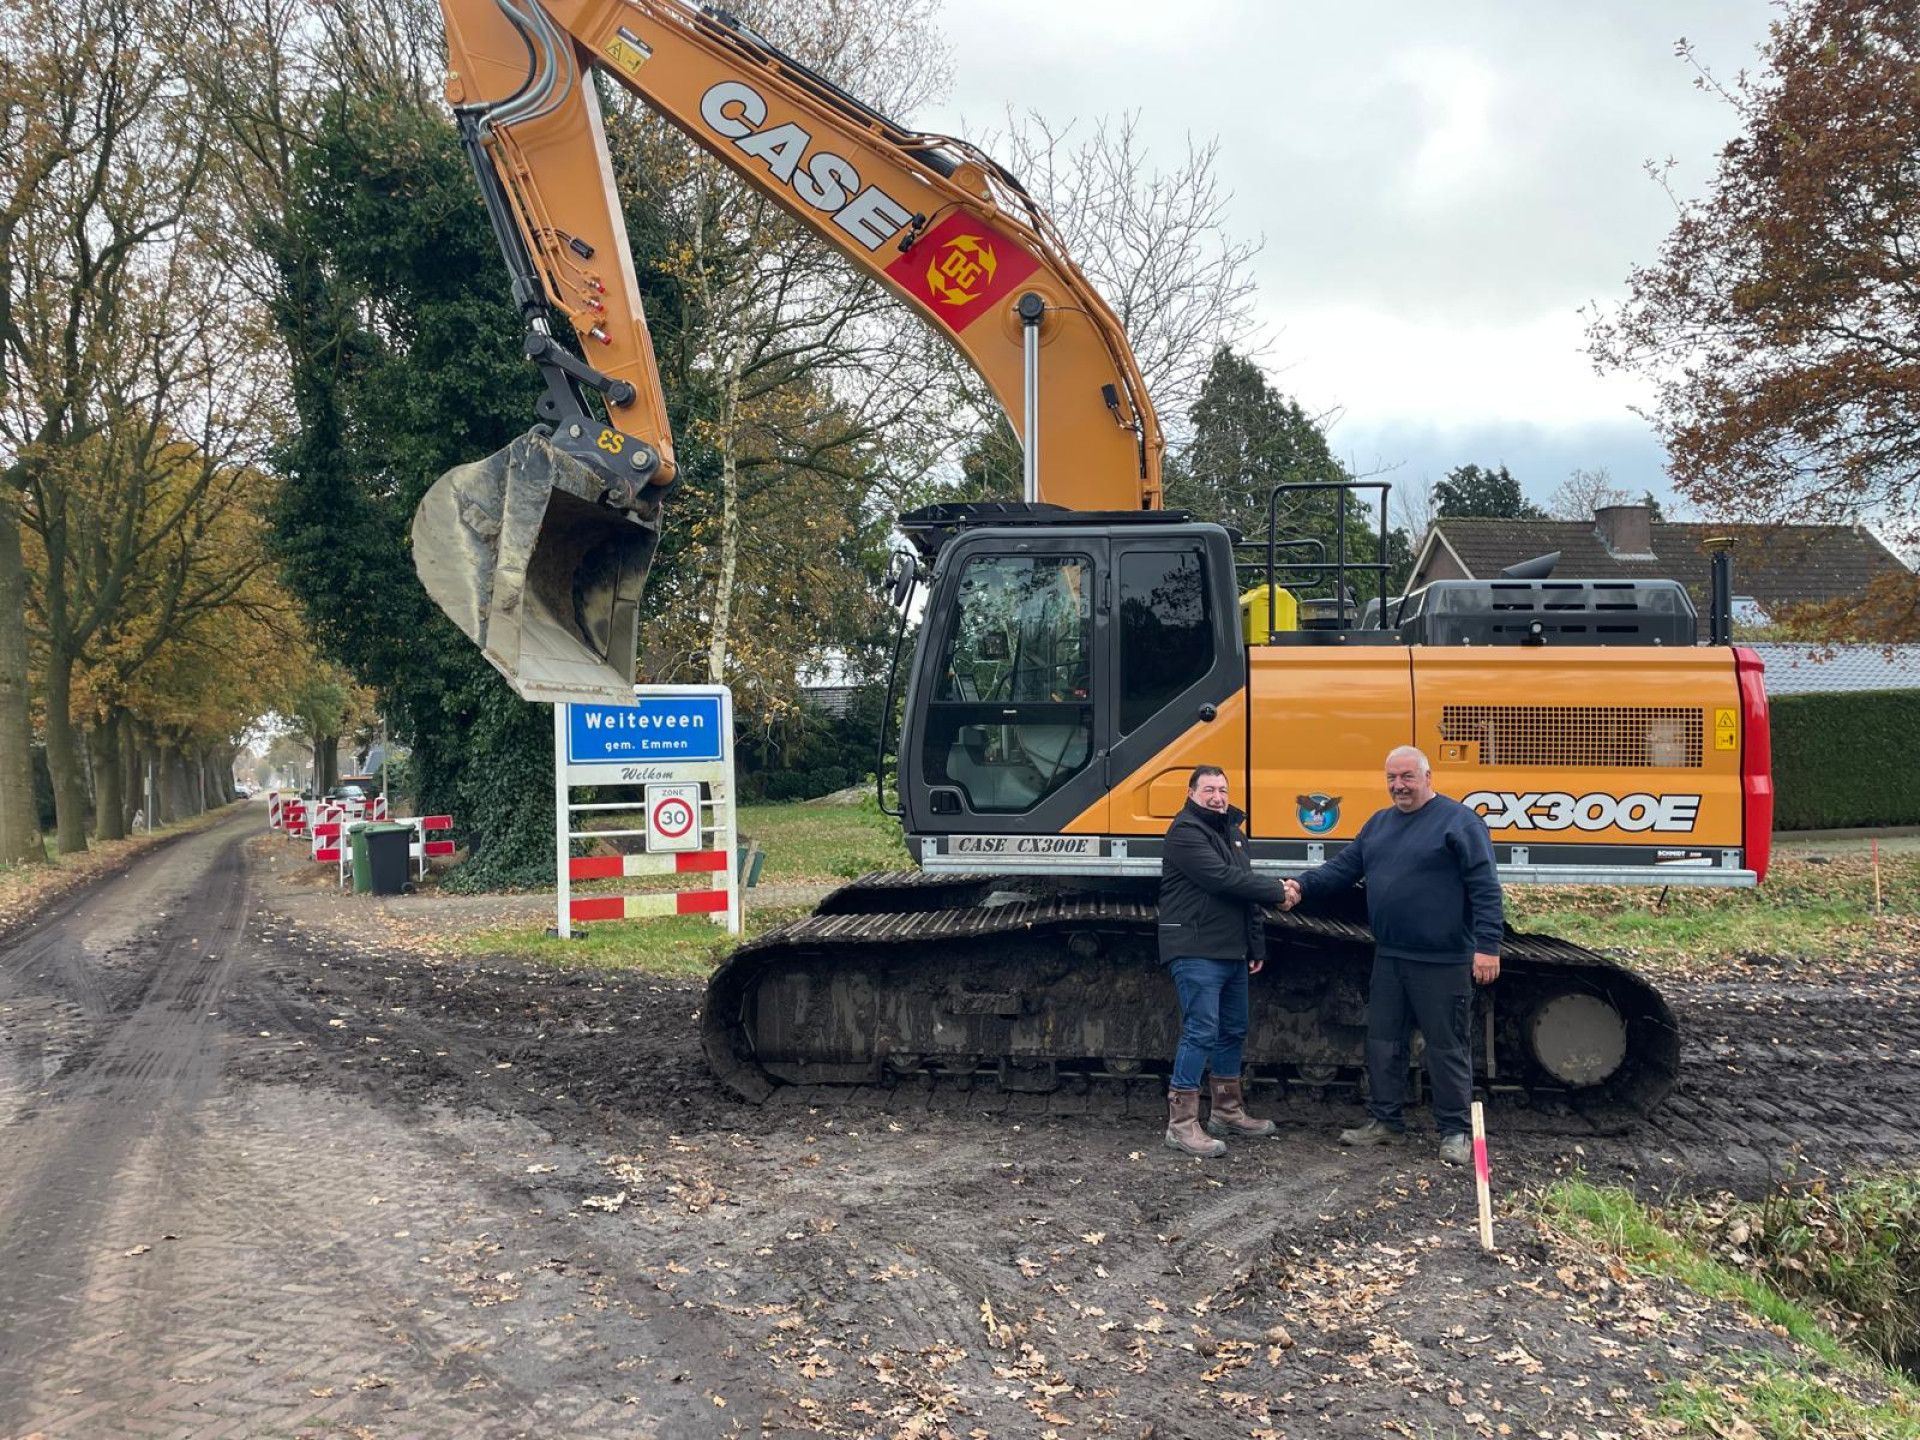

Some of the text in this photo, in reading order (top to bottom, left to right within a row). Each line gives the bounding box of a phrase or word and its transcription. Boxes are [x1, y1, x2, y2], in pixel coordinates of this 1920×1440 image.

[700, 81, 915, 252] CASE
[585, 712, 704, 729] Weiteveen
[605, 739, 688, 752] gem. Emmen
[621, 767, 674, 780] Welkom
[661, 810, 686, 825] 30
[1461, 791, 1702, 832] CX300E
[958, 838, 1088, 853] CASE CX300E
